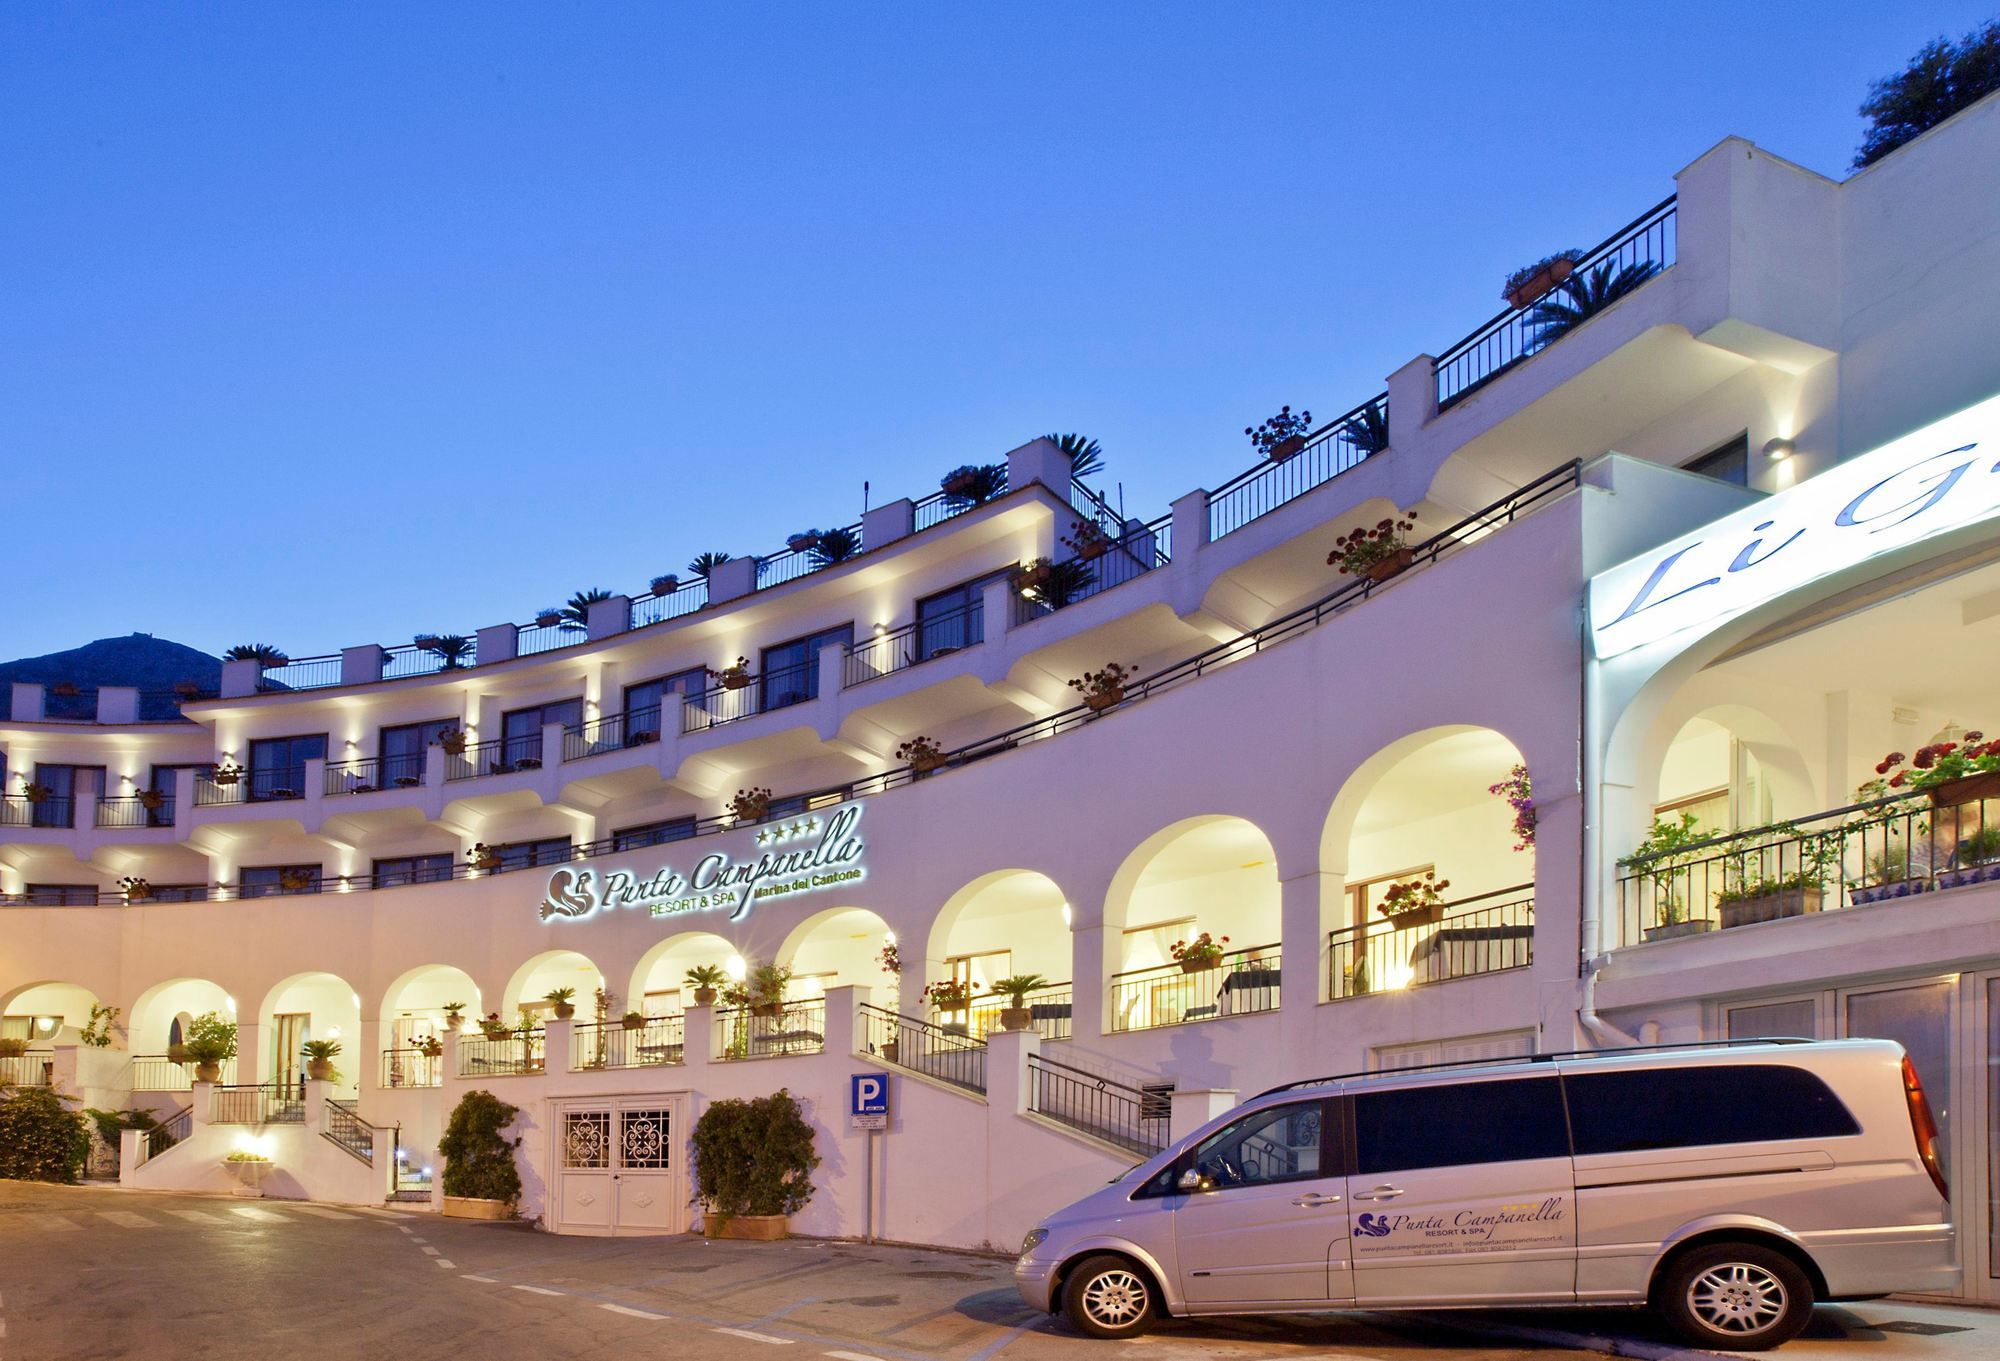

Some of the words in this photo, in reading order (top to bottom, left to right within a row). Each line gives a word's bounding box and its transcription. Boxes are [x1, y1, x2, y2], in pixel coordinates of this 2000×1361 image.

[1597, 520, 1806, 632] Li
[1834, 442, 2000, 534] G
[601, 869, 683, 907] Punta
[690, 806, 864, 920] Campanella
[753, 884, 790, 899] Marina
[792, 878, 808, 891] del
[811, 868, 862, 887] Cantone
[649, 898, 697, 917] RESORT
[700, 896, 708, 908] &
[712, 891, 736, 906] SPA
[858, 1078, 880, 1111] P
[1392, 1214, 1445, 1231] Punta
[1454, 1196, 1566, 1240] Campanella
[1425, 1229, 1458, 1237] RESORT
[1461, 1227, 1467, 1236] &
[1469, 1227, 1486, 1236] SPA
